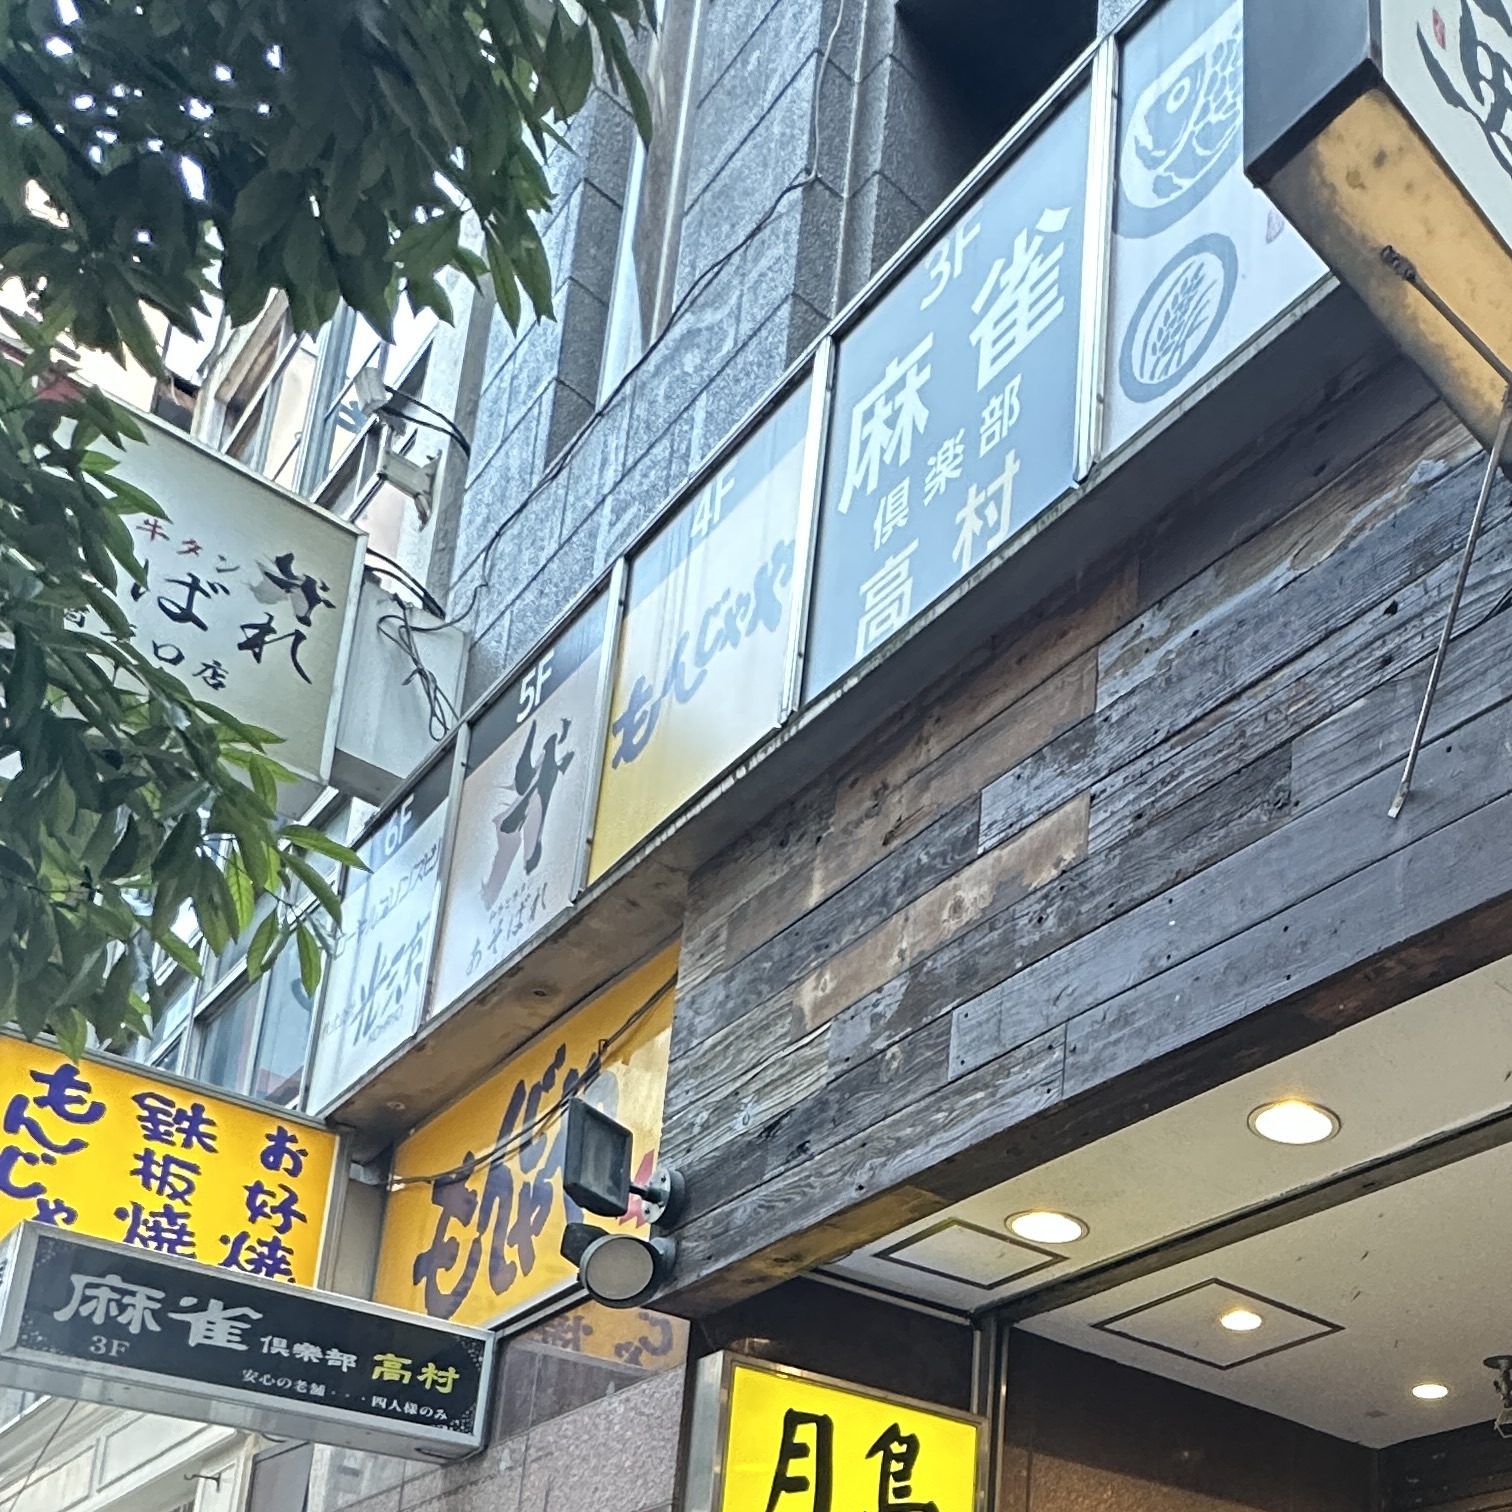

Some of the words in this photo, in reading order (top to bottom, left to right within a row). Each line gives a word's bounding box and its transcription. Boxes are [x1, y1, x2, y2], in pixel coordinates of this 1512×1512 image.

[919, 221, 981, 311] 3F
[838, 206, 1072, 515] 麻雀
[689, 474, 736, 540] 4F
[872, 373, 1023, 551] 倶楽部
[855, 455, 1021, 660] 高村
[515, 650, 556, 724] 5F
[383, 794, 416, 857] 6F
[53, 1272, 264, 1352] 麻雀
[260, 1333, 359, 1374] 倶楽部
[371, 1353, 461, 1395] 高村
[89, 1336, 131, 1359] 3F
